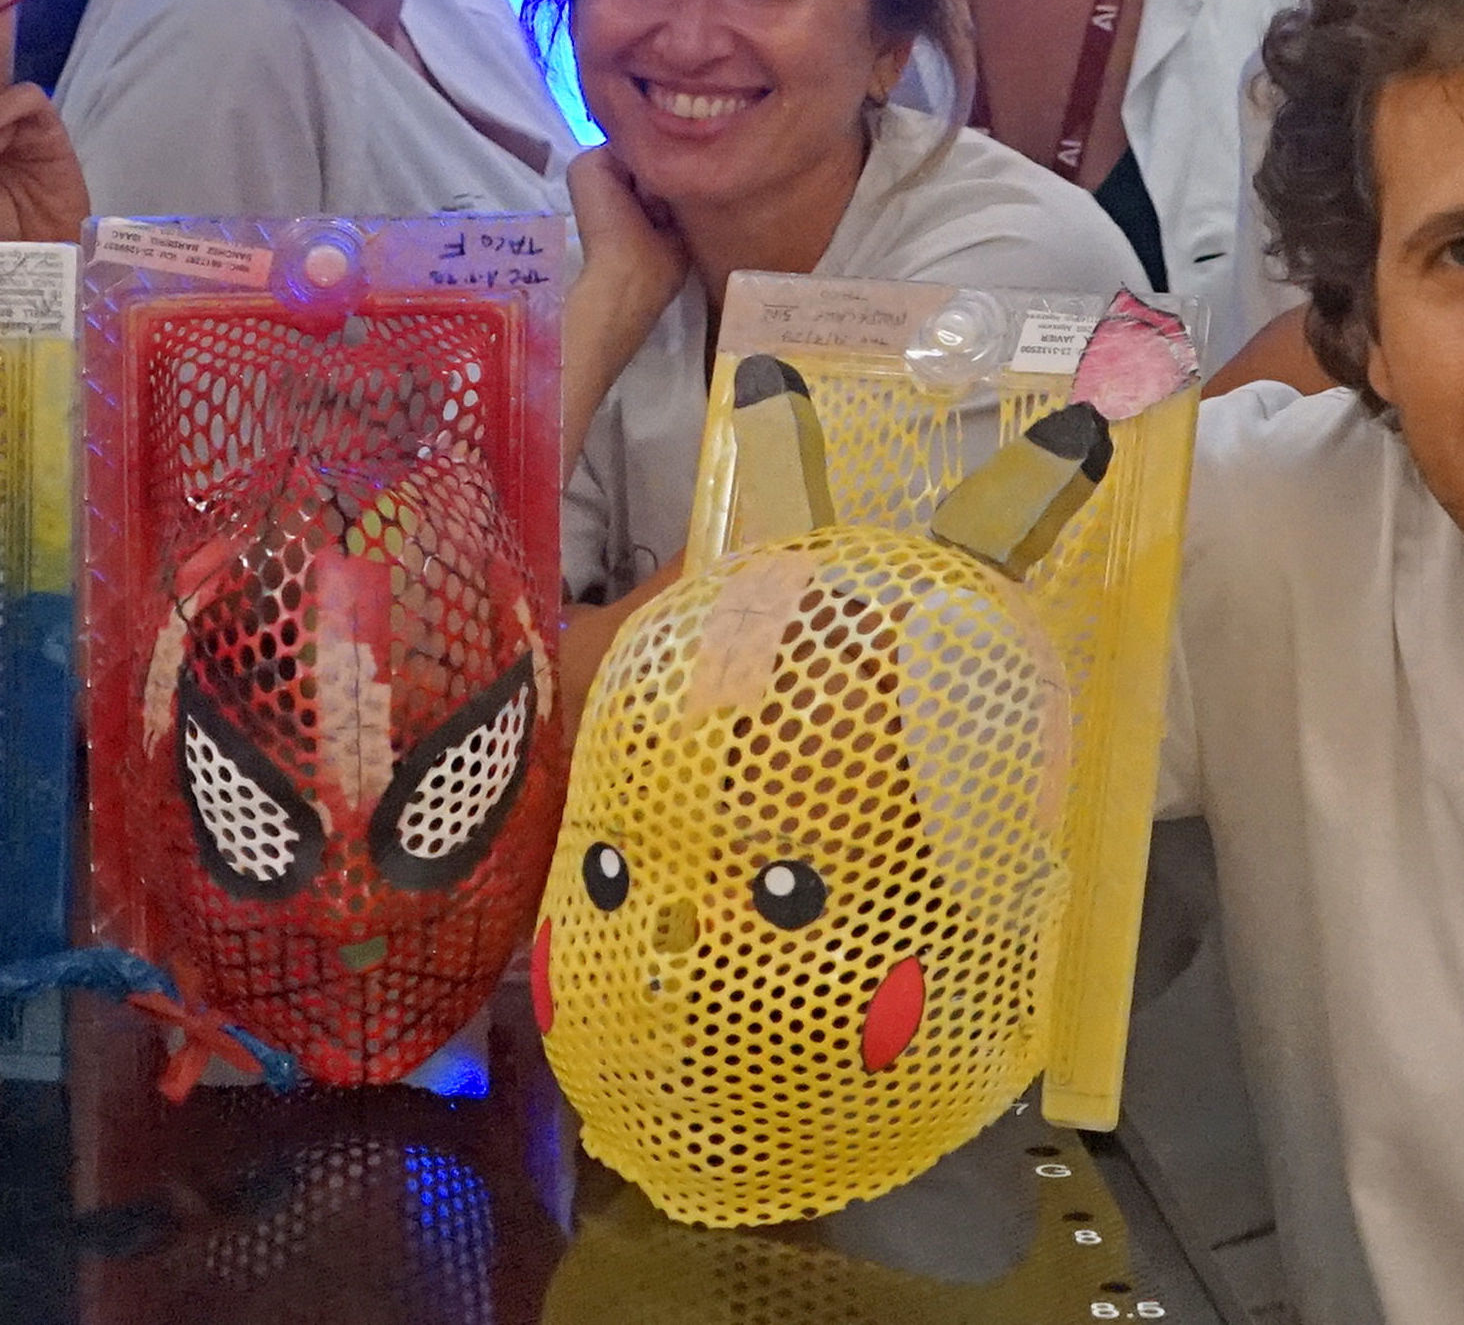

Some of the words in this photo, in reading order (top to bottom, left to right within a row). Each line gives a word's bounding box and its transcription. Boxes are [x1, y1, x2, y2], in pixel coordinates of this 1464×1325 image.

[439, 232, 466, 260] F
[1035, 1163, 1072, 1178] G
[1073, 1229, 1102, 1245] 8
[1090, 1301, 1166, 1319] 8.5
